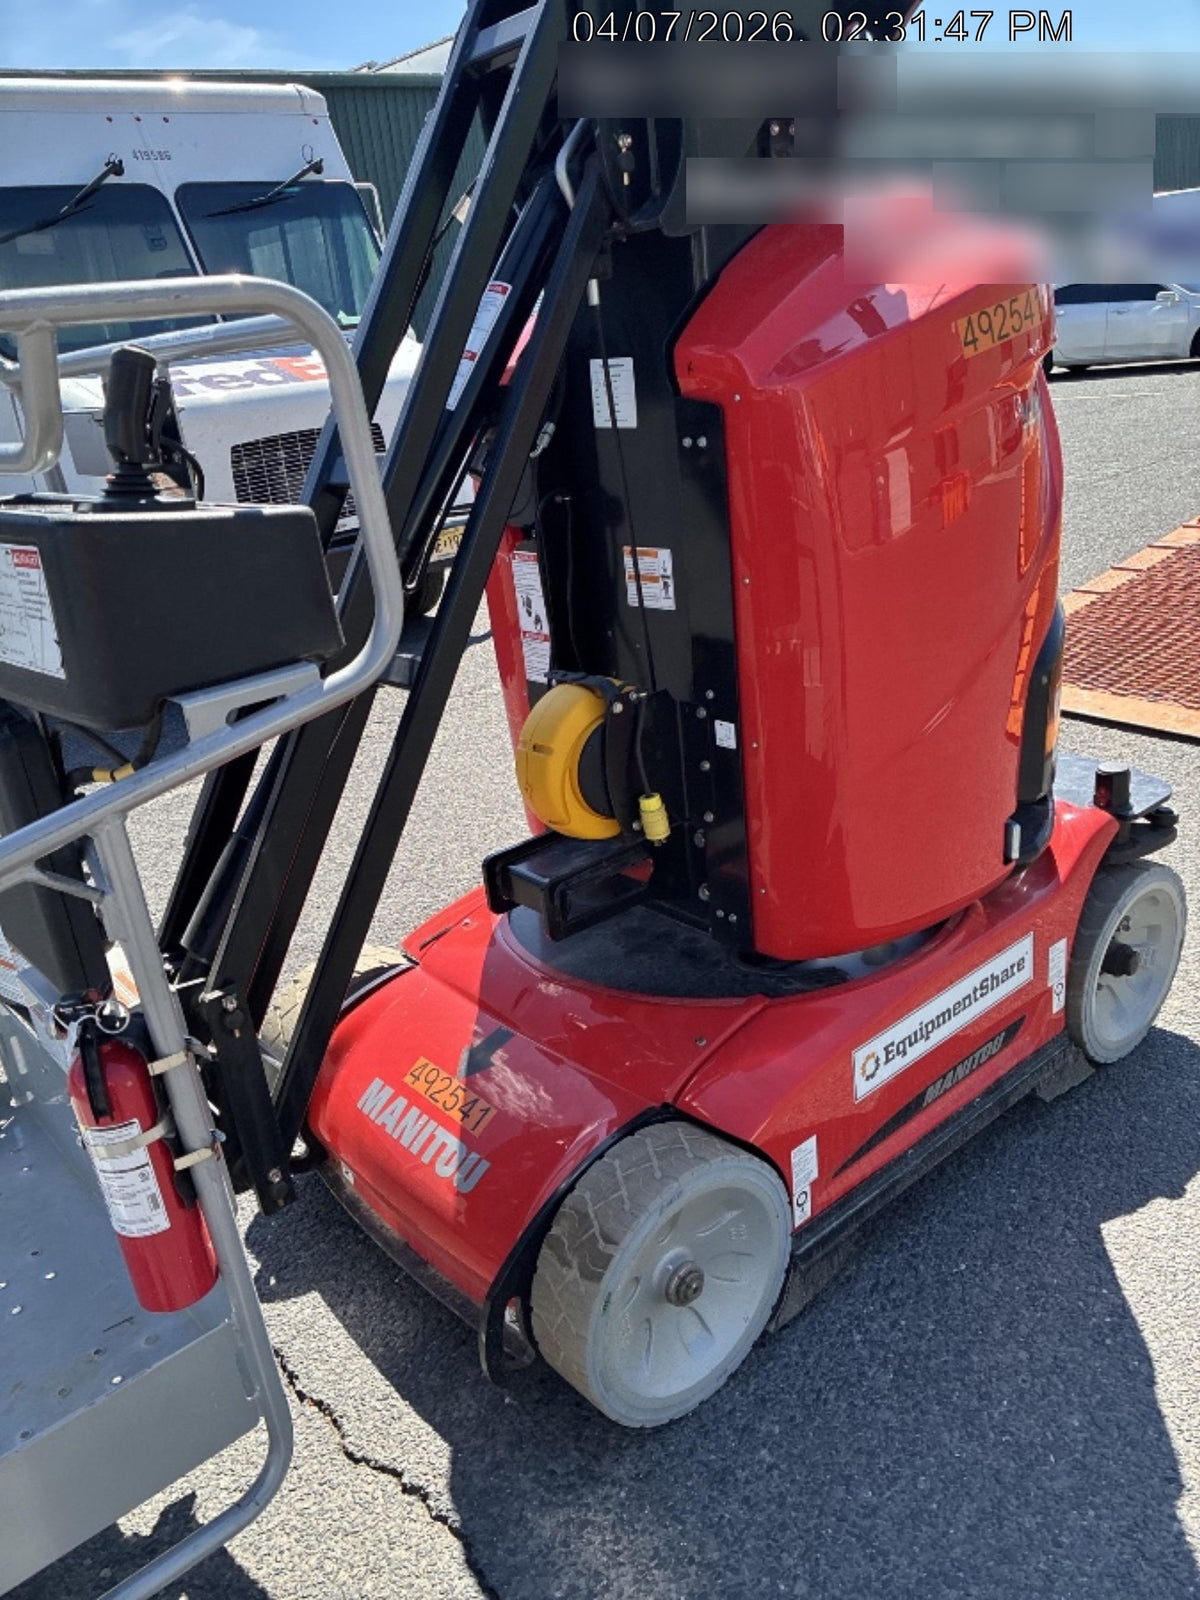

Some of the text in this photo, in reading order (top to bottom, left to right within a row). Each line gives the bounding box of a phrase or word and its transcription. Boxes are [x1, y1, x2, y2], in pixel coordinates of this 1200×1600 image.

[963, 286, 1042, 352] 492541
[170, 356, 330, 396] FedE
[882, 956, 1026, 1067] EquipmentShare
[409, 1062, 492, 1132] 492541
[922, 1031, 1006, 1108] MANITOU
[357, 1077, 491, 1194] MANITOU
